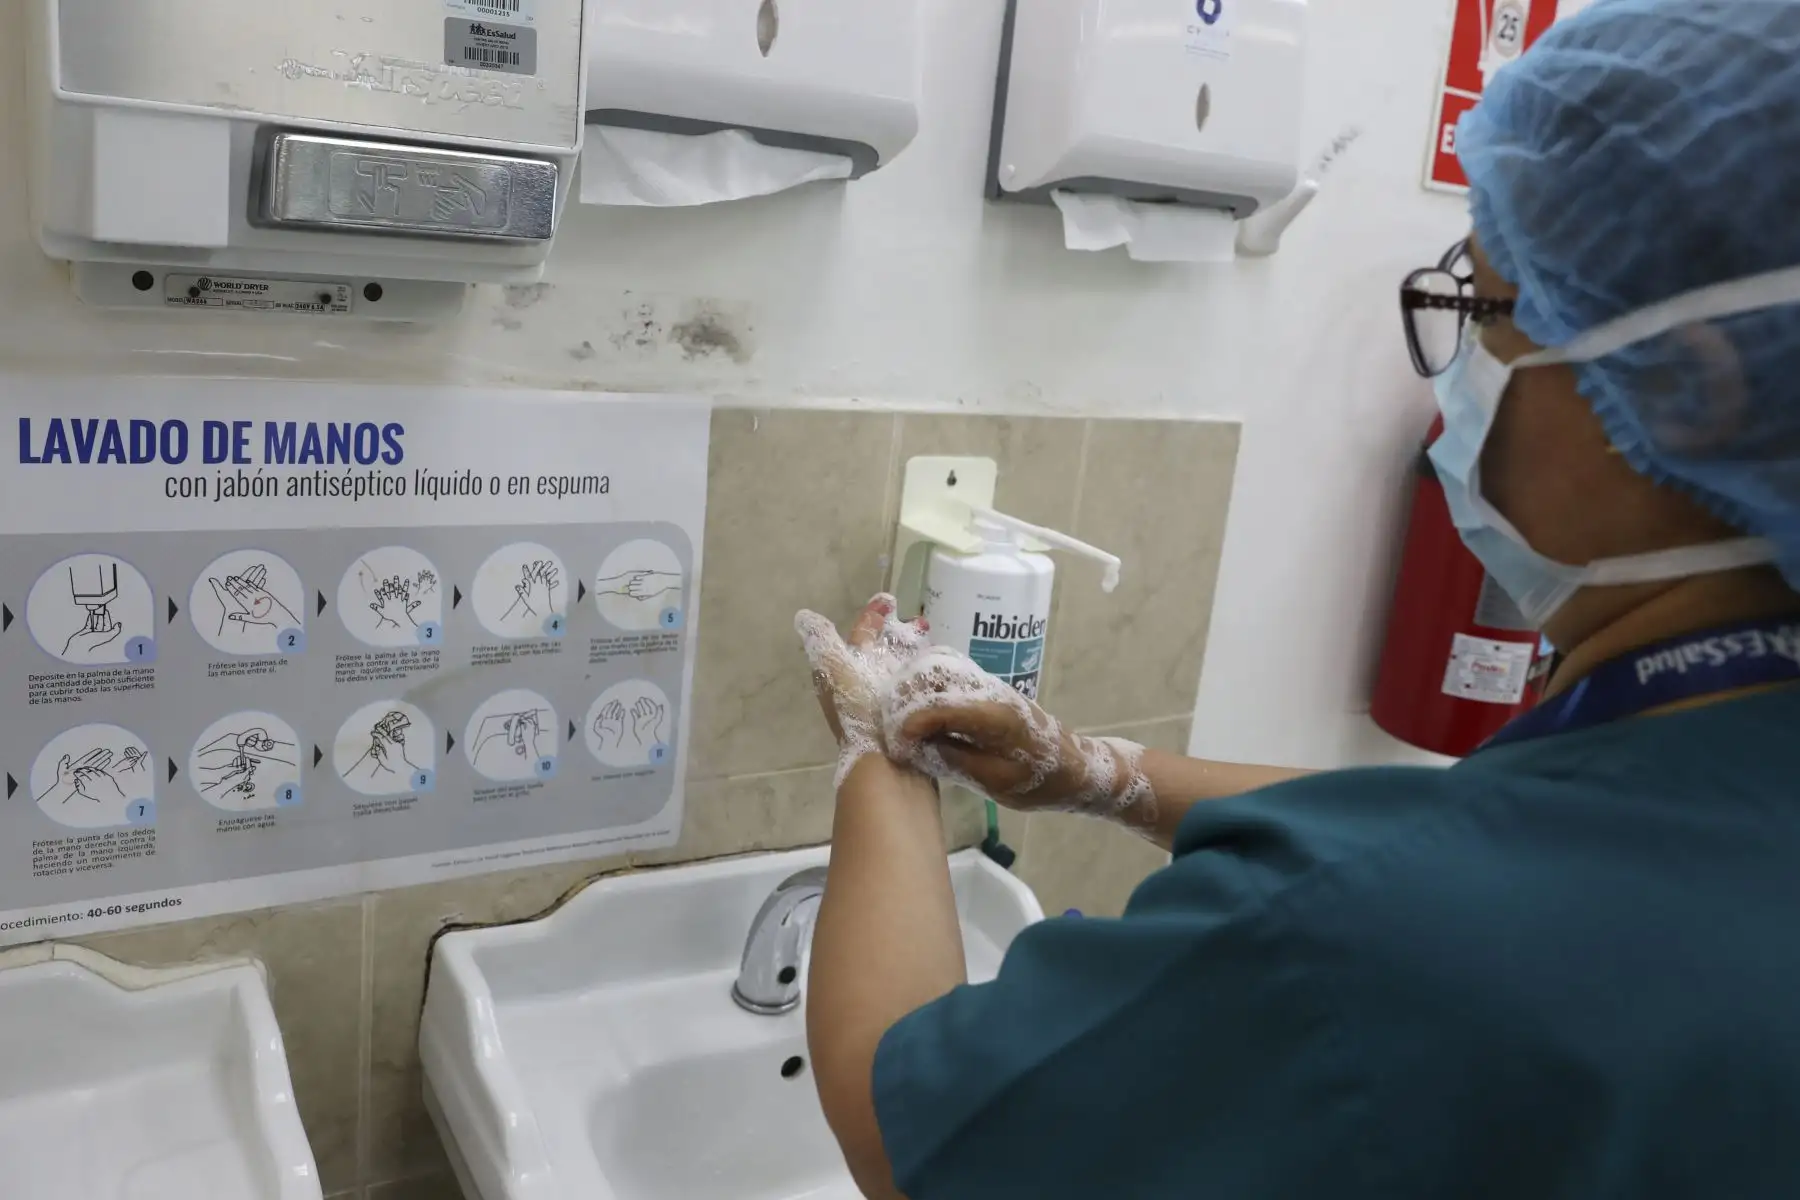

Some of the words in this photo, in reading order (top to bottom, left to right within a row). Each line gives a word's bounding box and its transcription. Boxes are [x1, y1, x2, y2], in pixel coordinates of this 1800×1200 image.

[1497, 14, 1519, 42] 25
[486, 29, 516, 40] EsSalud
[214, 281, 241, 290] WORLD
[19, 418, 189, 464] LAVADO
[202, 420, 252, 465] DE
[264, 421, 405, 466] MANOS
[165, 476, 207, 498] con
[214, 469, 278, 502] jabón
[287, 468, 407, 502] antiséptico
[414, 468, 482, 501] líquido
[490, 476, 500, 496] o
[508, 475, 530, 495] en
[537, 475, 610, 500] espuma
[667, 613, 674, 623] 5
[552, 620, 558, 631] 4
[426, 628, 433, 638] 3
[288, 635, 295, 646] 2
[137, 643, 143, 655] 1
[399, 650, 408, 658] de
[1635, 629, 1767, 685] EsSalud
[208, 662, 236, 670] Frótese
[238, 660, 249, 668] las
[250, 660, 276, 668] palmas
[278, 658, 288, 666] de
[28, 673, 64, 683] Deposite
[77, 671, 85, 679] la
[86, 670, 111, 680] palma
[112, 668, 122, 676] de
[132, 667, 155, 675] mano
[46, 680, 81, 689] cantidad
[82, 678, 93, 686] de
[93, 676, 116, 687] jabón
[117, 674, 155, 684] suficiente
[28, 690, 48, 698] para
[50, 687, 74, 696] cubrir
[76, 686, 98, 694] todas
[113, 682, 155, 693] superficies
[41, 697, 53, 705] las
[541, 761, 551, 771] 10
[420, 775, 426, 785] 9
[286, 789, 292, 800] 8
[139, 805, 145, 817] 7
[32, 839, 63, 849] Frótese
[77, 835, 101, 844] punta
[132, 828, 156, 837] dedos
[32, 848, 44, 856] de
[57, 845, 82, 853] mano
[84, 841, 117, 850] derecha
[120, 838, 145, 846] contra
[32, 855, 58, 864] palma
[90, 848, 114, 856] mano
[117, 843, 156, 854] izquierda,
[32, 860, 73, 870] haciendo
[91, 851, 142, 863] movimiento
[145, 849, 156, 857] de
[32, 867, 67, 878] rotación
[87, 905, 122, 919] 40-60
[125, 897, 182, 915] segundos
